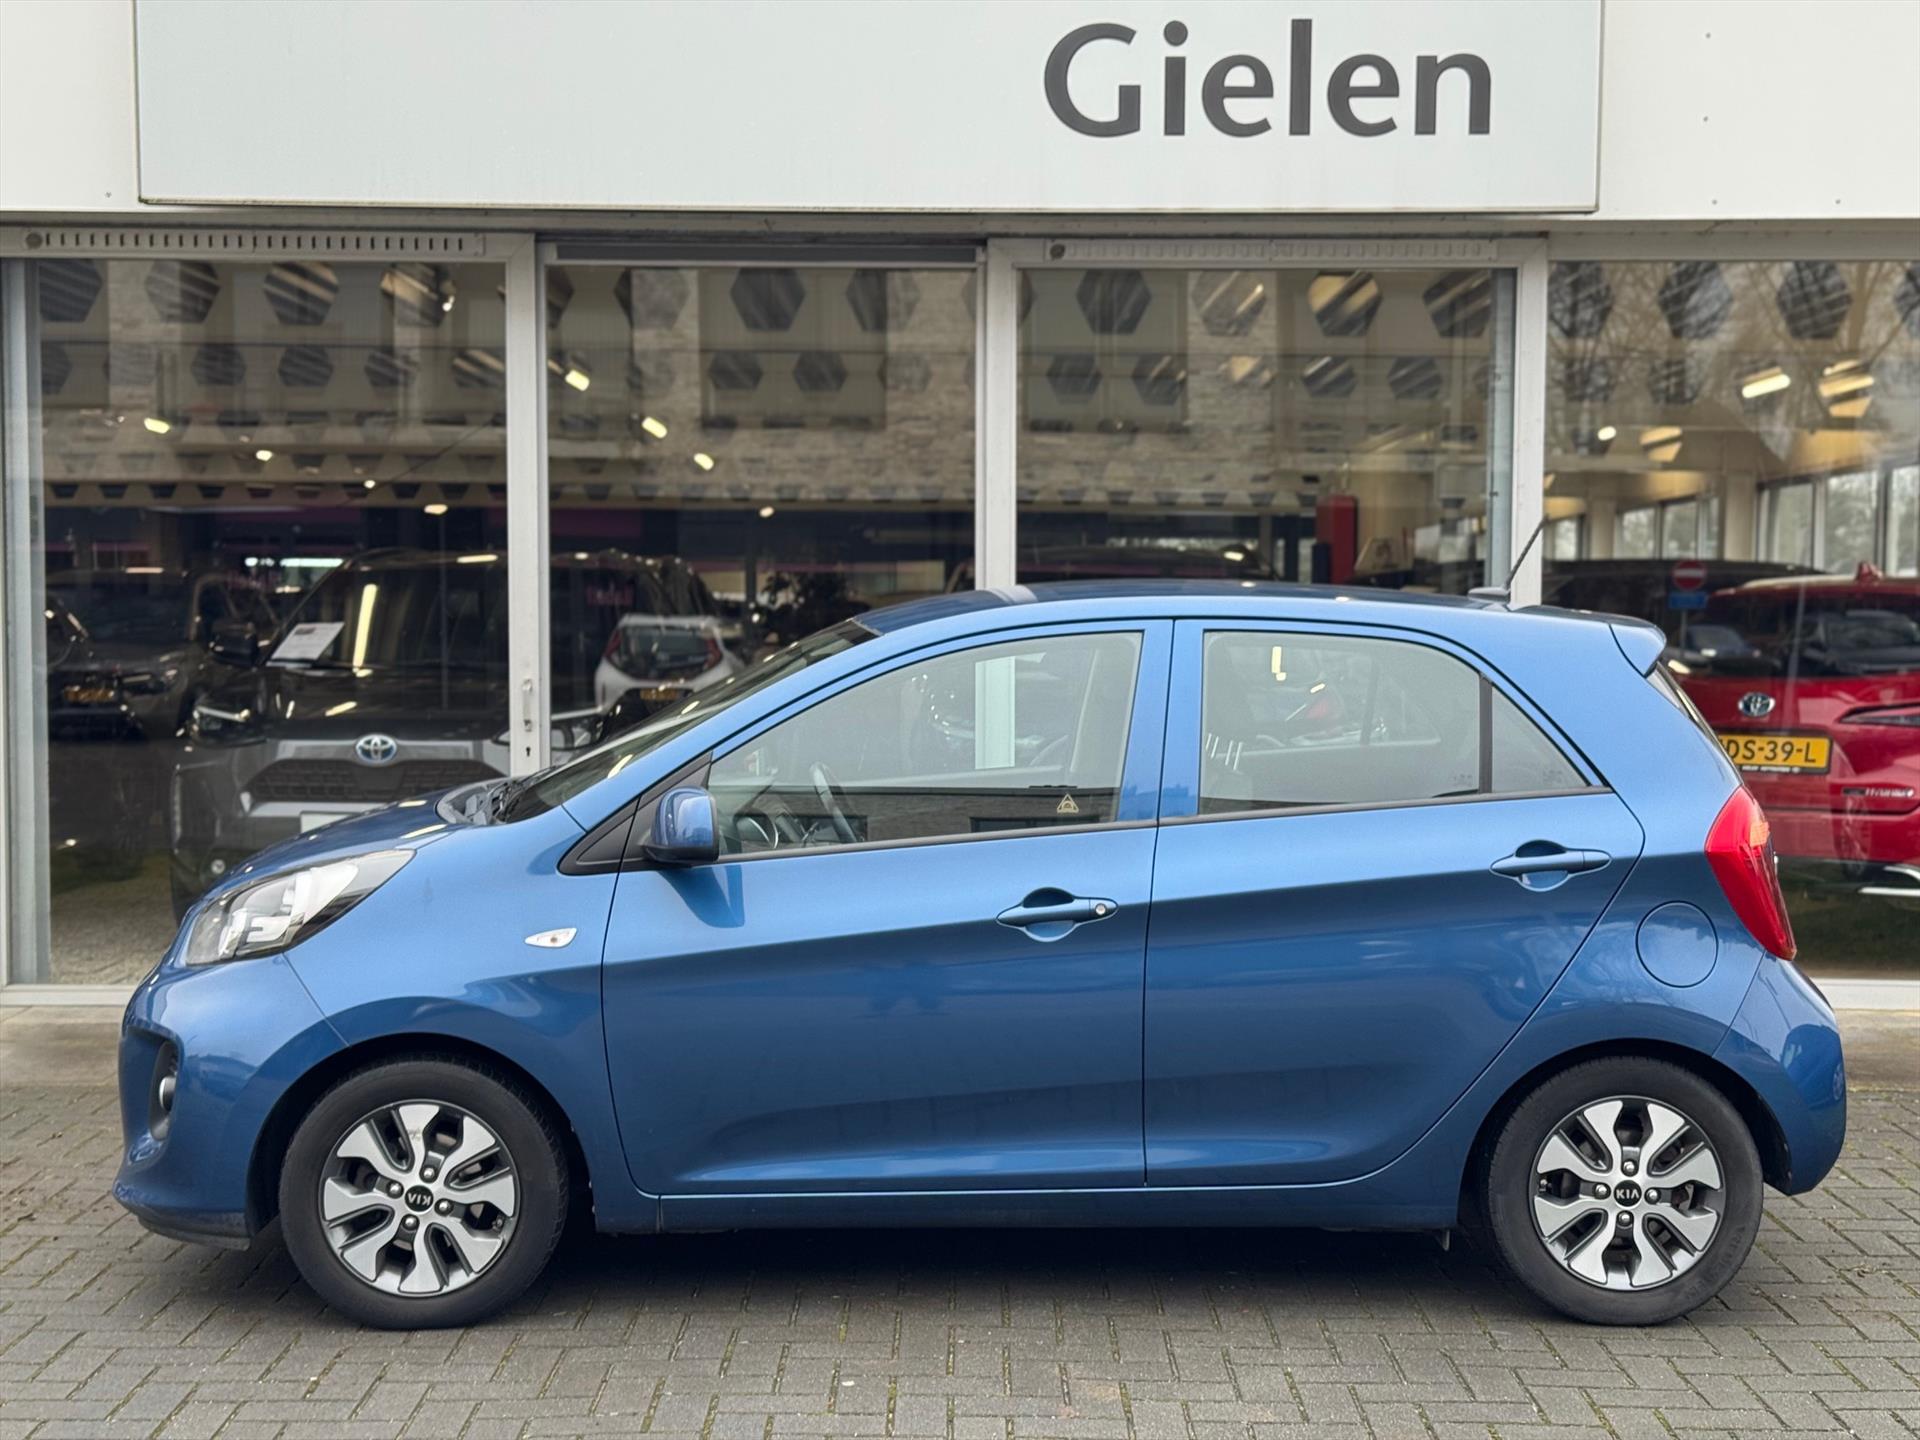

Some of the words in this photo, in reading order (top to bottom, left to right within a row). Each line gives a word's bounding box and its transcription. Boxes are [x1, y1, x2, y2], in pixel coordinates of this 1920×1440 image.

[1043, 18, 1492, 137] Gielen
[1720, 739, 1816, 763] DS-39-L
[408, 1192, 431, 1206] KIA
[1616, 1188, 1639, 1199] KIA
